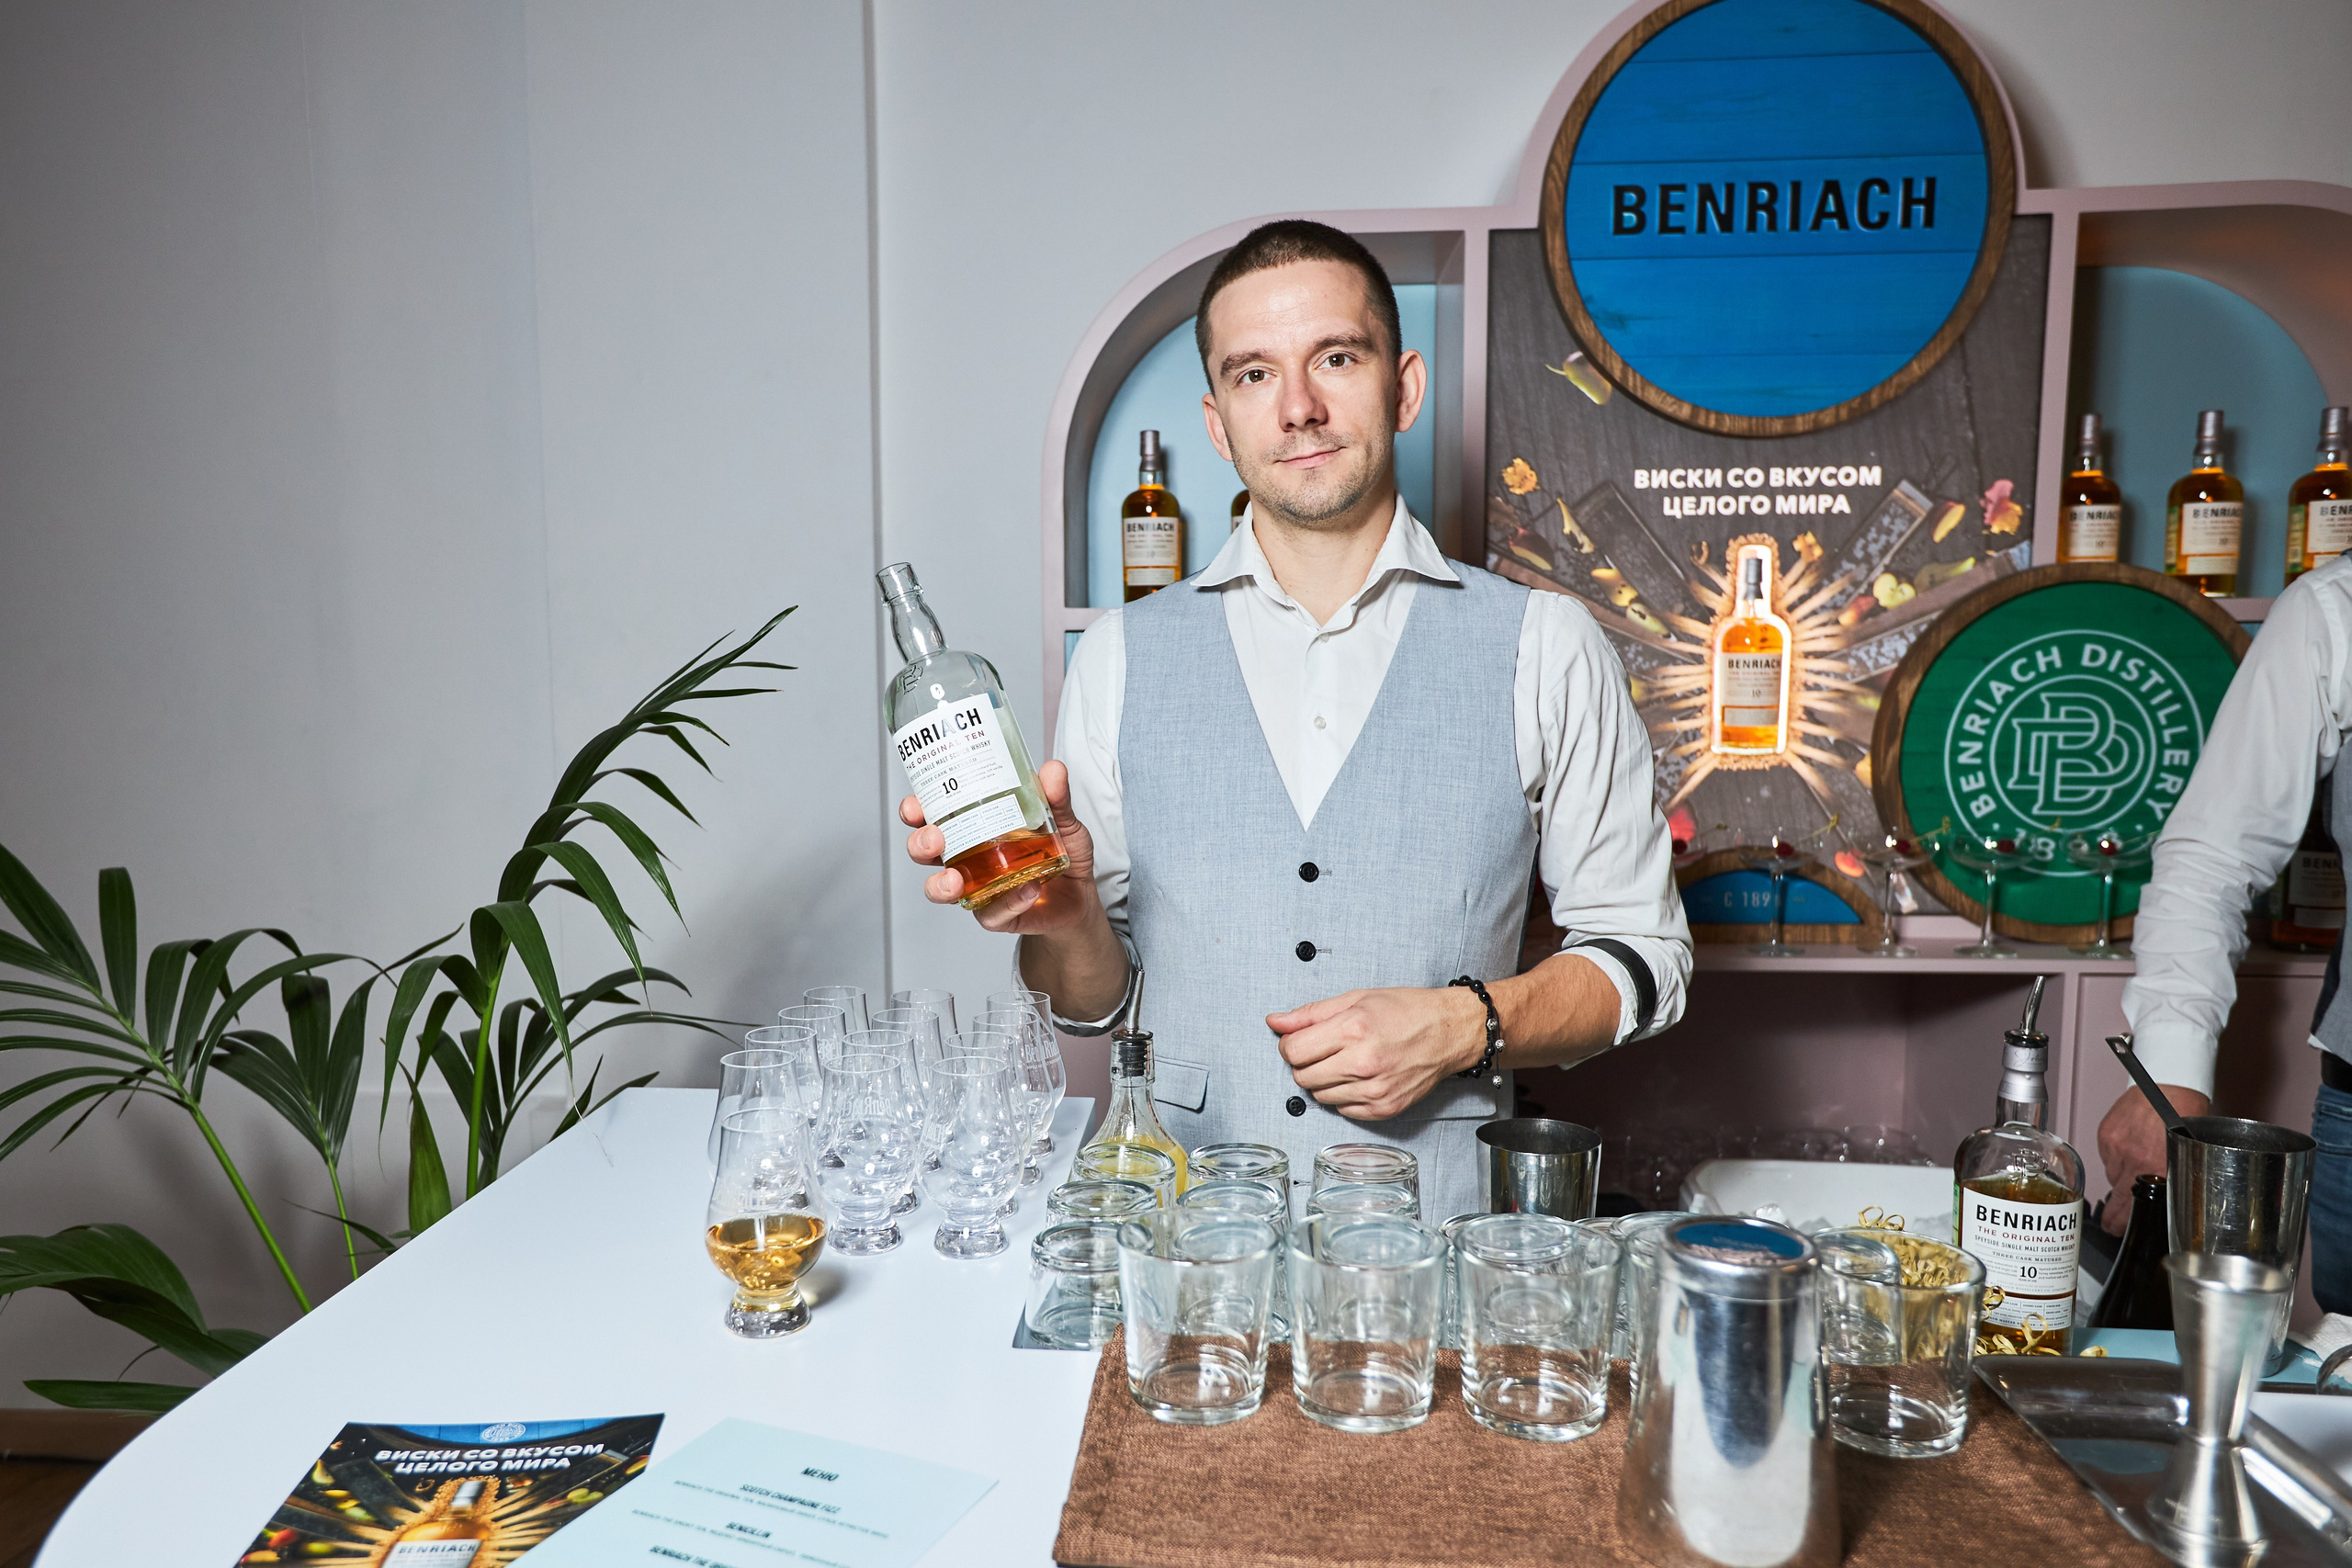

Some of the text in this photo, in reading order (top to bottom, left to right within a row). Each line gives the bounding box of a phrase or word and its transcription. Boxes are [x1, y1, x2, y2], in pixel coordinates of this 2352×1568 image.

[1612, 176, 1938, 236] BENRIACH
[1634, 465, 1883, 489] ВИСКИ СО ВКУСОМ
[1662, 493, 1852, 519] ЦЕЛОГО МИРА
[898, 708, 982, 761] BENRIACH
[1957, 642, 2190, 821] BENRIACH DISTILLERY
[906, 729, 985, 772] THE ORIGINAL TEN
[936, 756, 948, 766] MALT
[970, 739, 991, 751] WHISKY
[934, 770, 948, 779] CASK
[943, 778, 958, 795] 10
[1976, 1204, 2076, 1232] BENRIACH
[1974, 1235, 1999, 1247] SPEYSIDE
[2001, 1242, 2022, 1250] SINGLE
[1978, 1225, 2075, 1243] THE ORIGINAL TEN
[1992, 1251, 2014, 1259] THREE
[2019, 1266, 2038, 1279] 10
[374, 1443, 605, 1461] ВИСКИ СО ВКУСОМ
[395, 1457, 571, 1475] ЦЕЛОГО МИРА
[801, 1467, 840, 1481] МЕНЮ
[740, 1483, 842, 1514] SCOTCH CHAMPAGNE FIZZ
[399, 1544, 477, 1553] BENRIACH
